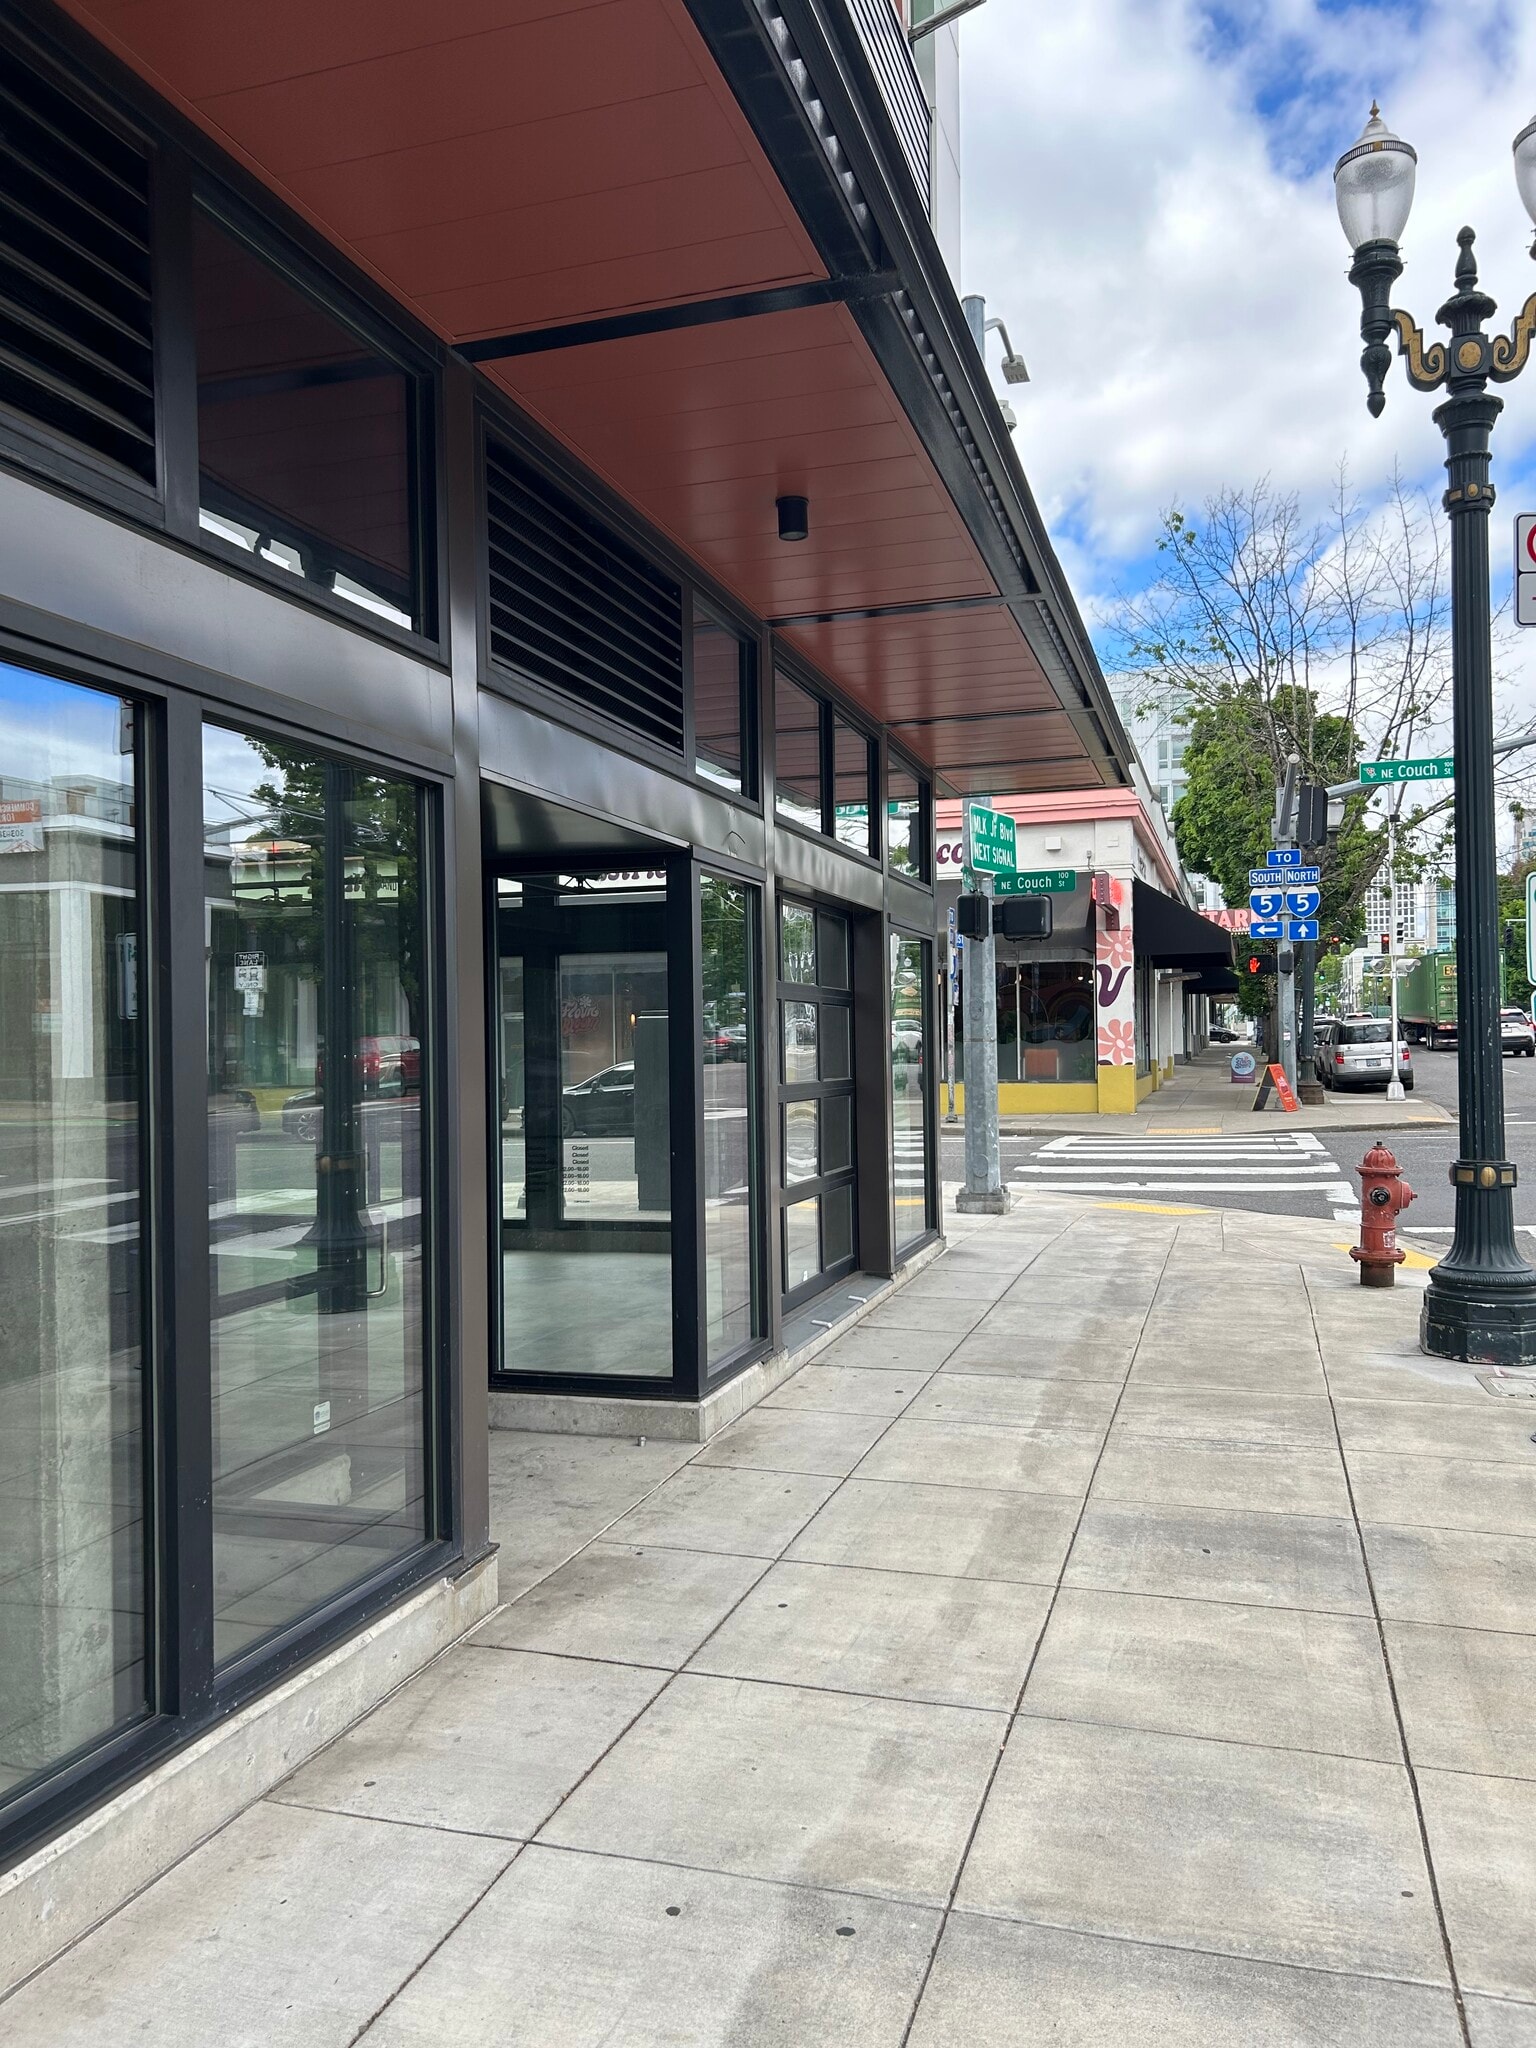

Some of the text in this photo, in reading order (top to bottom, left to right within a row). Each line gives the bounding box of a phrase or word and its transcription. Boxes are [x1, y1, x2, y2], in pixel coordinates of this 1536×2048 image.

[1381, 762, 1438, 779] NE Couch
[973, 814, 1014, 843] MLK Jr Blvd
[973, 840, 1016, 868] NEXT SIGNAL
[1275, 853, 1292, 863] TO
[1001, 875, 1052, 890] NE Couch
[1058, 871, 1069, 879] 100
[1251, 872, 1282, 883] SOUTH
[1287, 870, 1318, 882] NORTH
[1260, 895, 1273, 914] 5
[1296, 893, 1310, 912] 5
